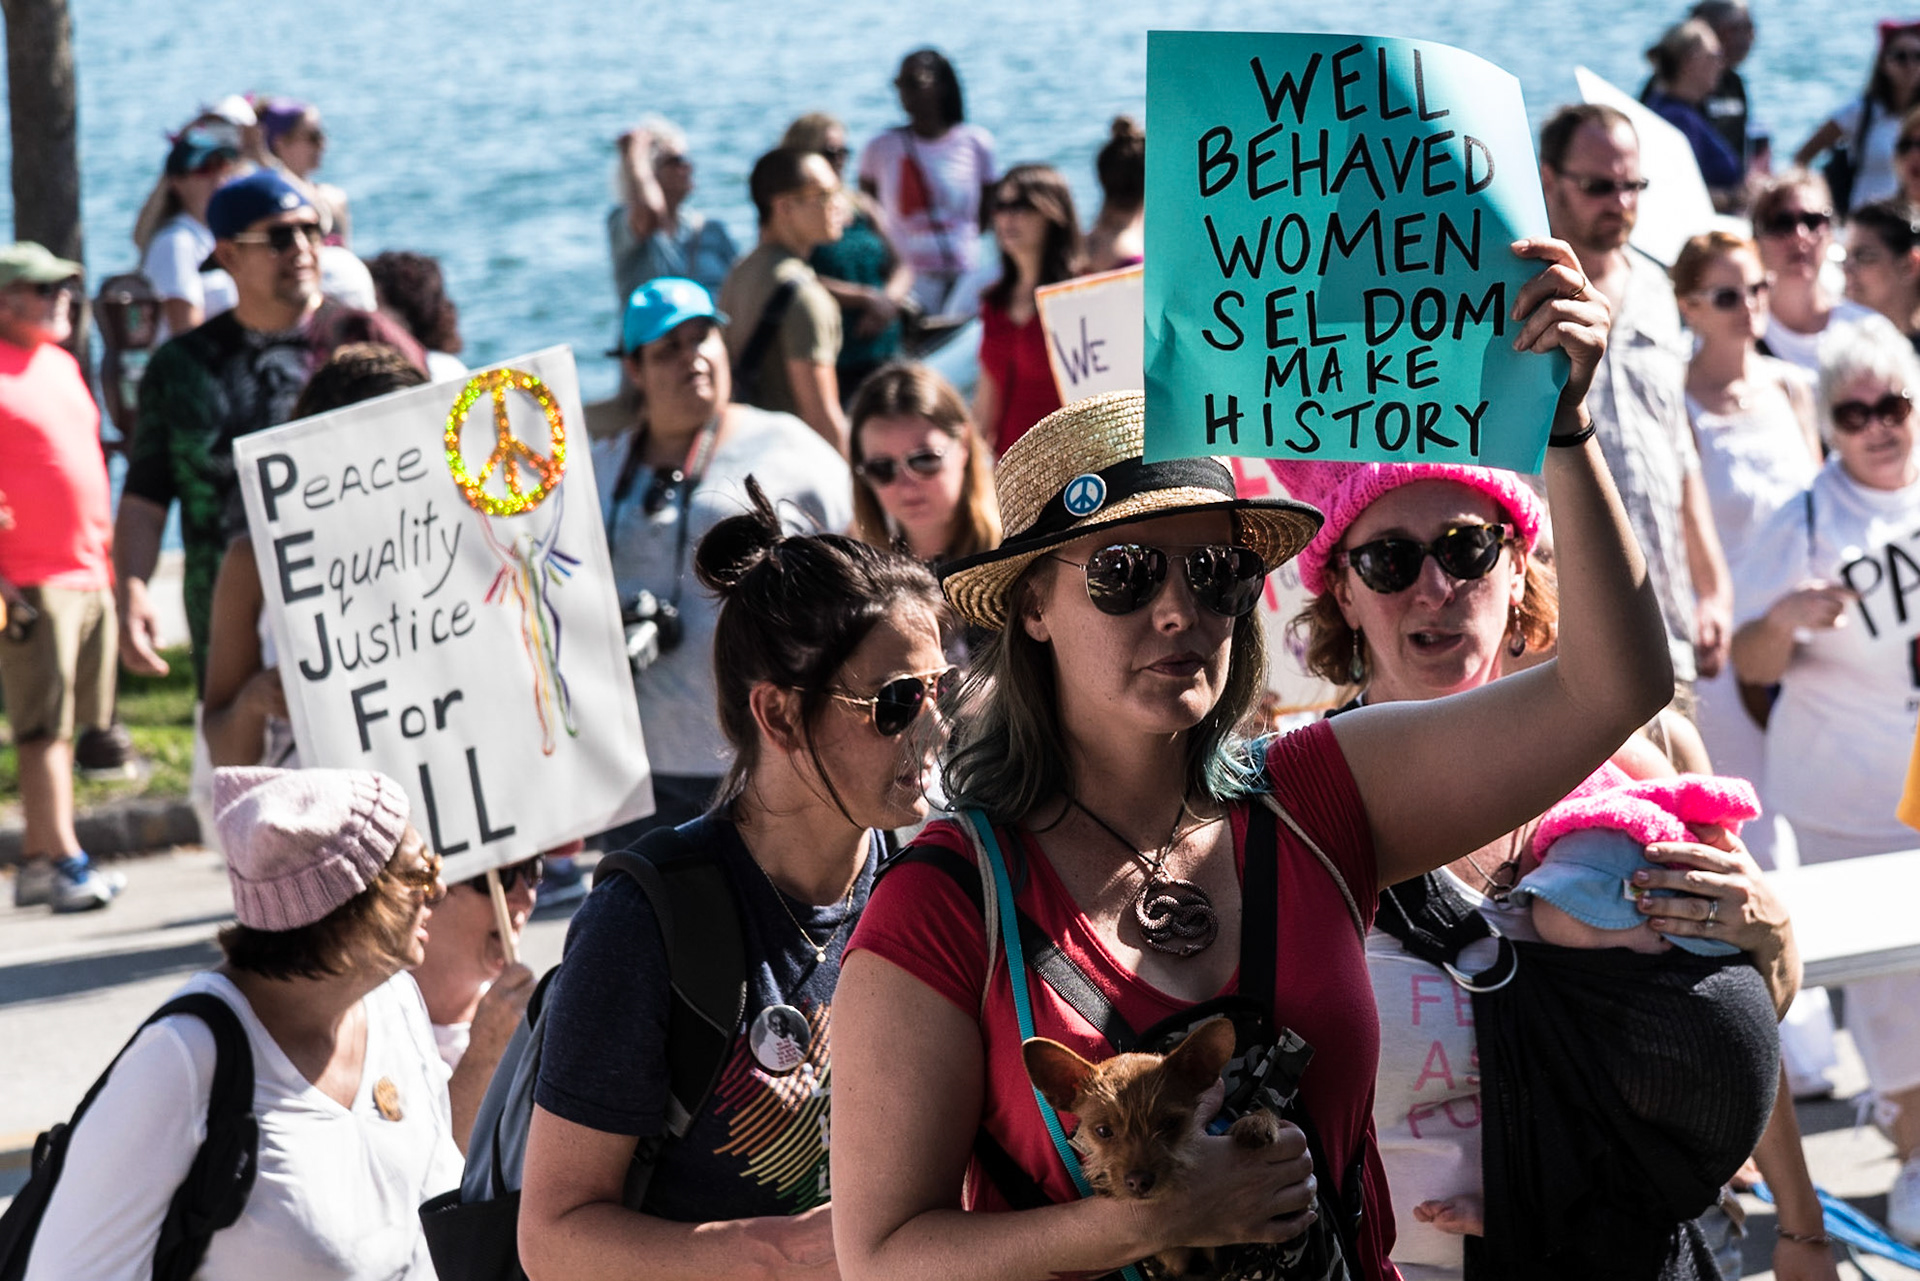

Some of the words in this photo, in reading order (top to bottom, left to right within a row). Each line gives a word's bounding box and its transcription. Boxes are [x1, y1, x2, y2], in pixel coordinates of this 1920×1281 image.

[1250, 43, 1449, 124] WELL
[1198, 123, 1495, 201] BEHAVED
[1204, 208, 1481, 279] WOMEN
[1202, 282, 1505, 351] SELDOM
[1264, 346, 1440, 397] MAKE
[1205, 394, 1489, 456] HISTORY
[1840, 530, 1920, 638] PA
[299, 599, 475, 682] Justice
[350, 680, 463, 752] For
[418, 747, 516, 857] LL
